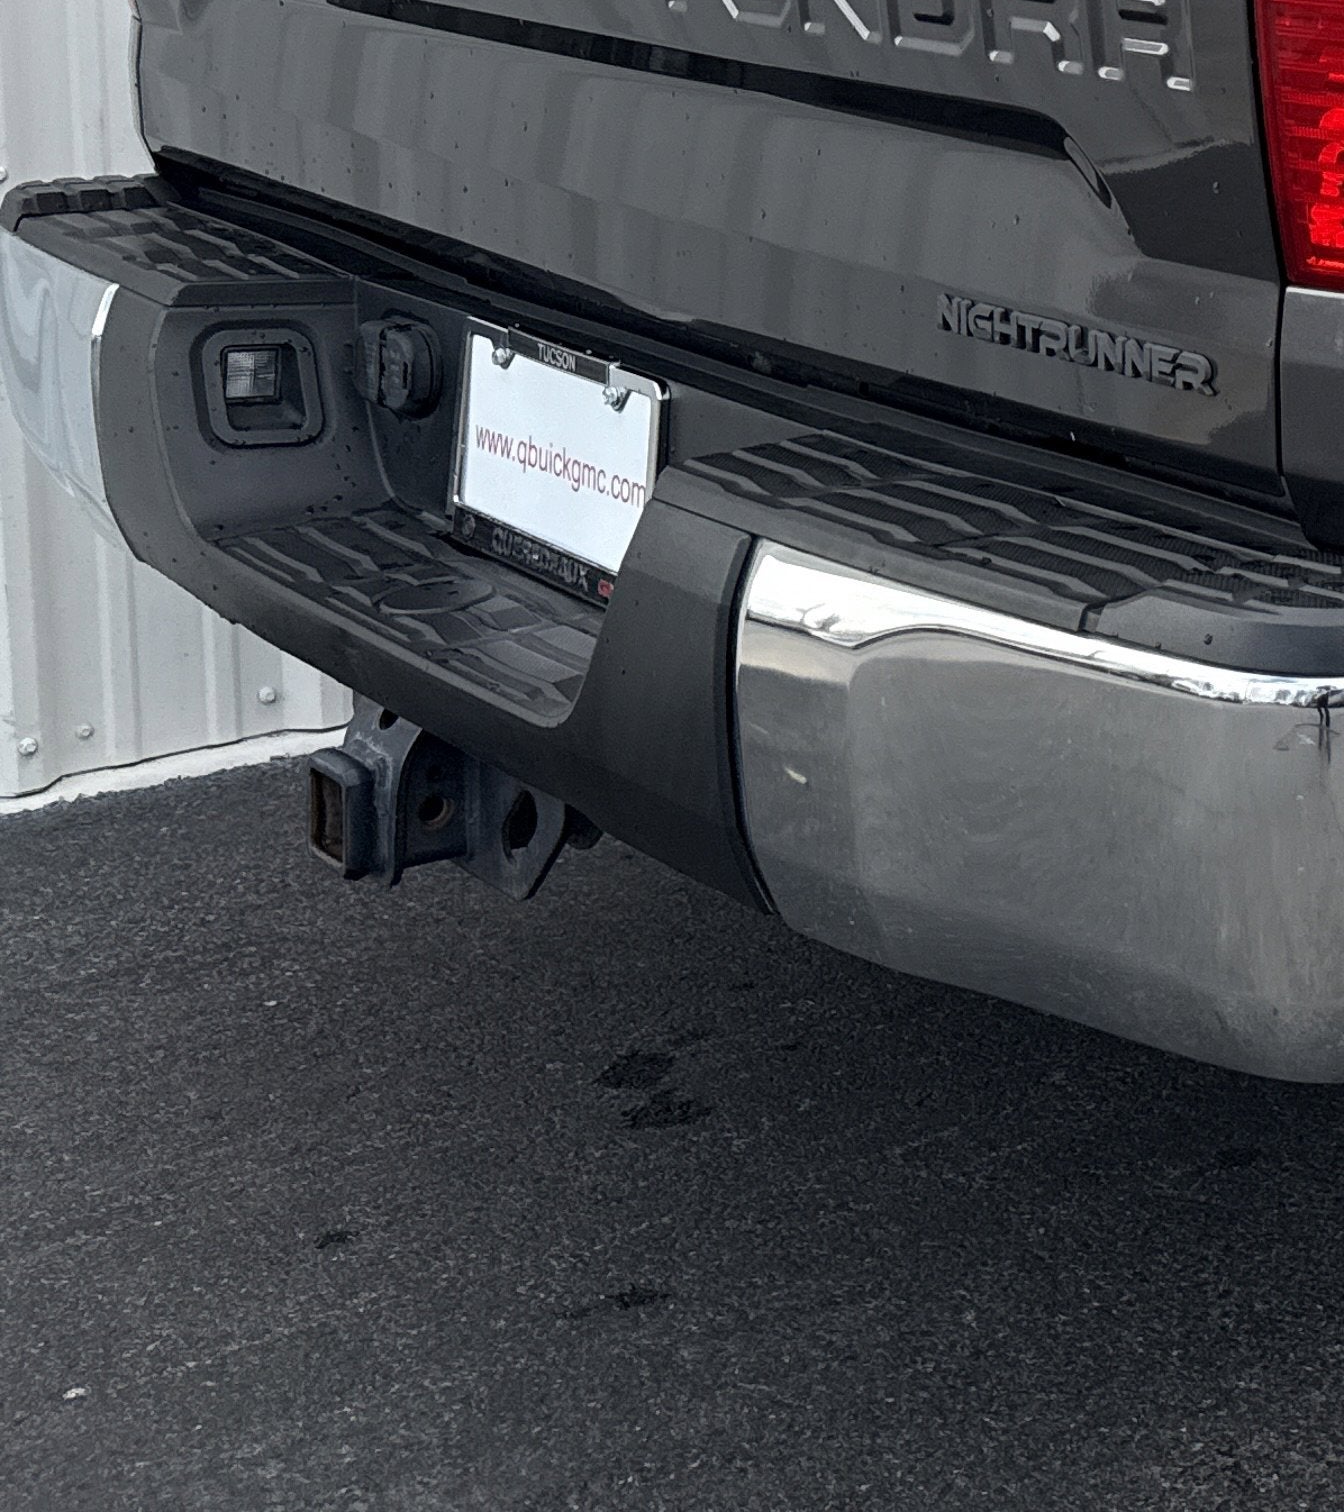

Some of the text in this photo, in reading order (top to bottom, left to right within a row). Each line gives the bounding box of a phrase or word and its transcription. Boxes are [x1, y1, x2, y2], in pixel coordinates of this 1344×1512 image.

[537, 341, 577, 373] TUCSON
[936, 292, 1220, 397] NIGHTRUNNER
[474, 424, 647, 509] www.qbuickgmc.com
